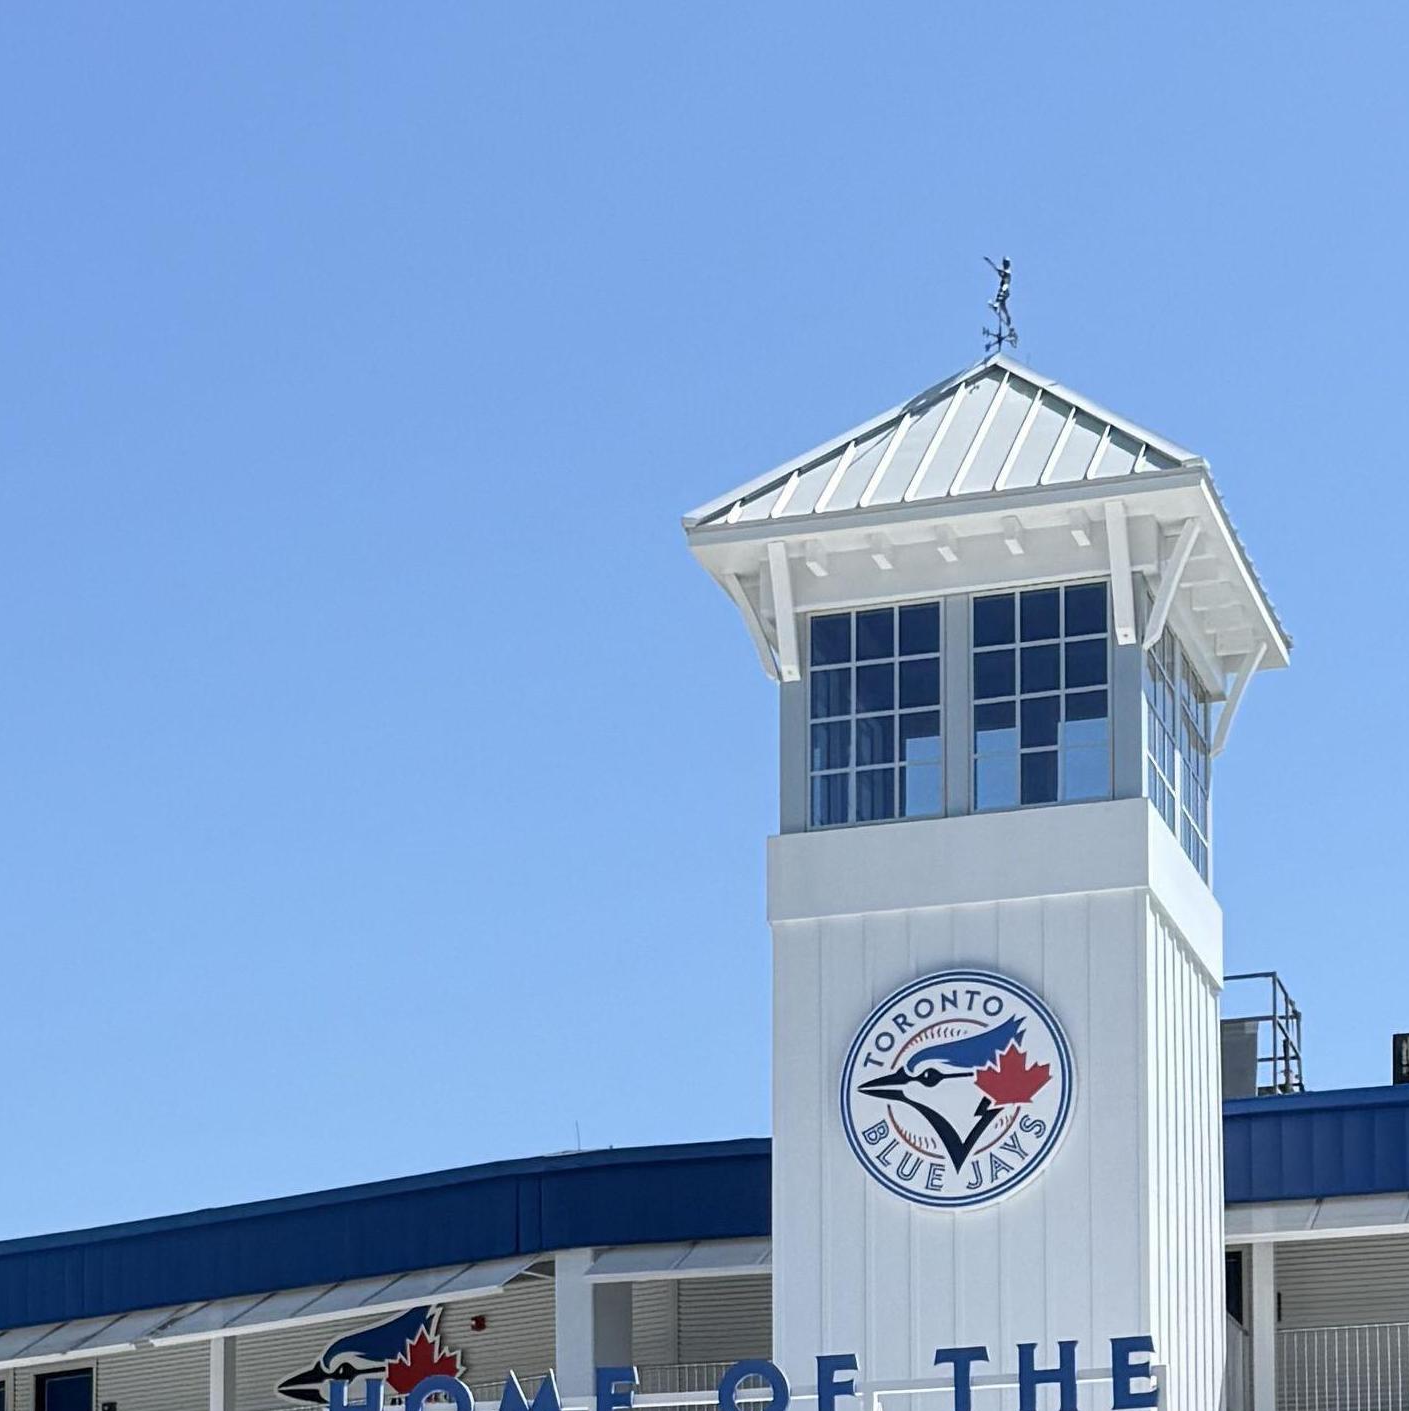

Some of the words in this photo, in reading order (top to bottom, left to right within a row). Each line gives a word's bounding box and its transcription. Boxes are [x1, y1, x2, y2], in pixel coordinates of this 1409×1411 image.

[863, 989, 1004, 1071] TORONTO
[861, 1118, 947, 1191] BLUE
[966, 1113, 1047, 1190] JAYS
